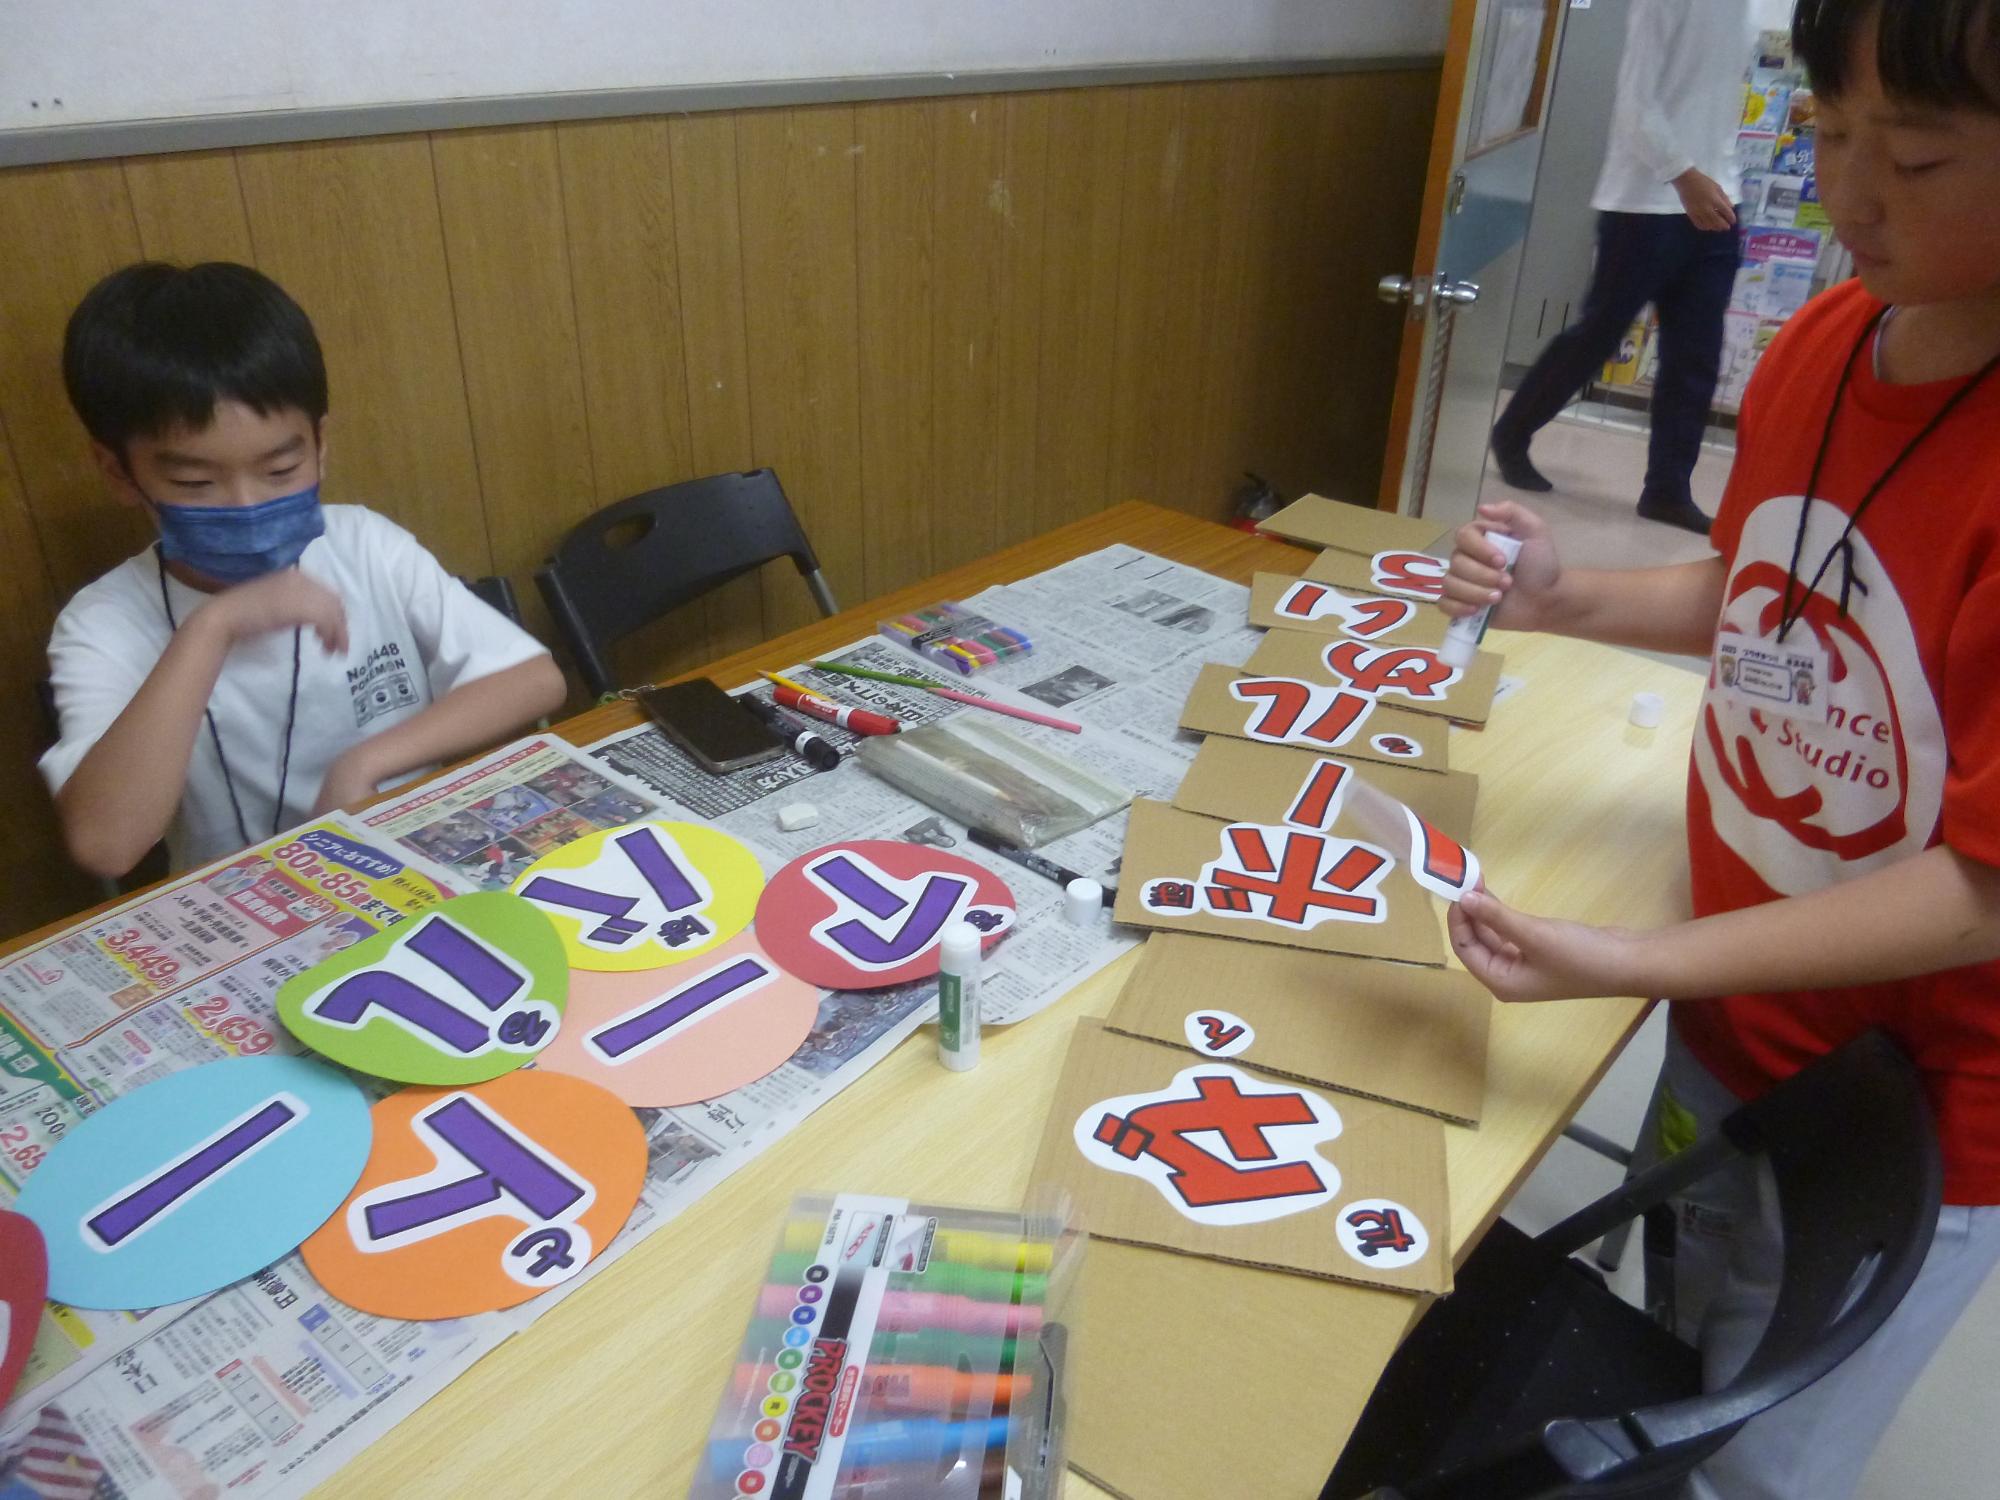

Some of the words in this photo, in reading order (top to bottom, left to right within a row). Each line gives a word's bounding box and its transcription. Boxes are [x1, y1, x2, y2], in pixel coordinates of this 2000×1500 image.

[1284, 585, 1408, 637] い
[1327, 641, 1455, 697] め
[1236, 680, 1370, 744] ル
[1777, 718, 1891, 790] Studio
[1204, 828, 1387, 924] ボ
[313, 915, 526, 1054] ル
[1196, 1015, 1246, 1052] ん
[1093, 1076, 1328, 1208] ダ
[782, 1338, 849, 1463] PROCKEY
